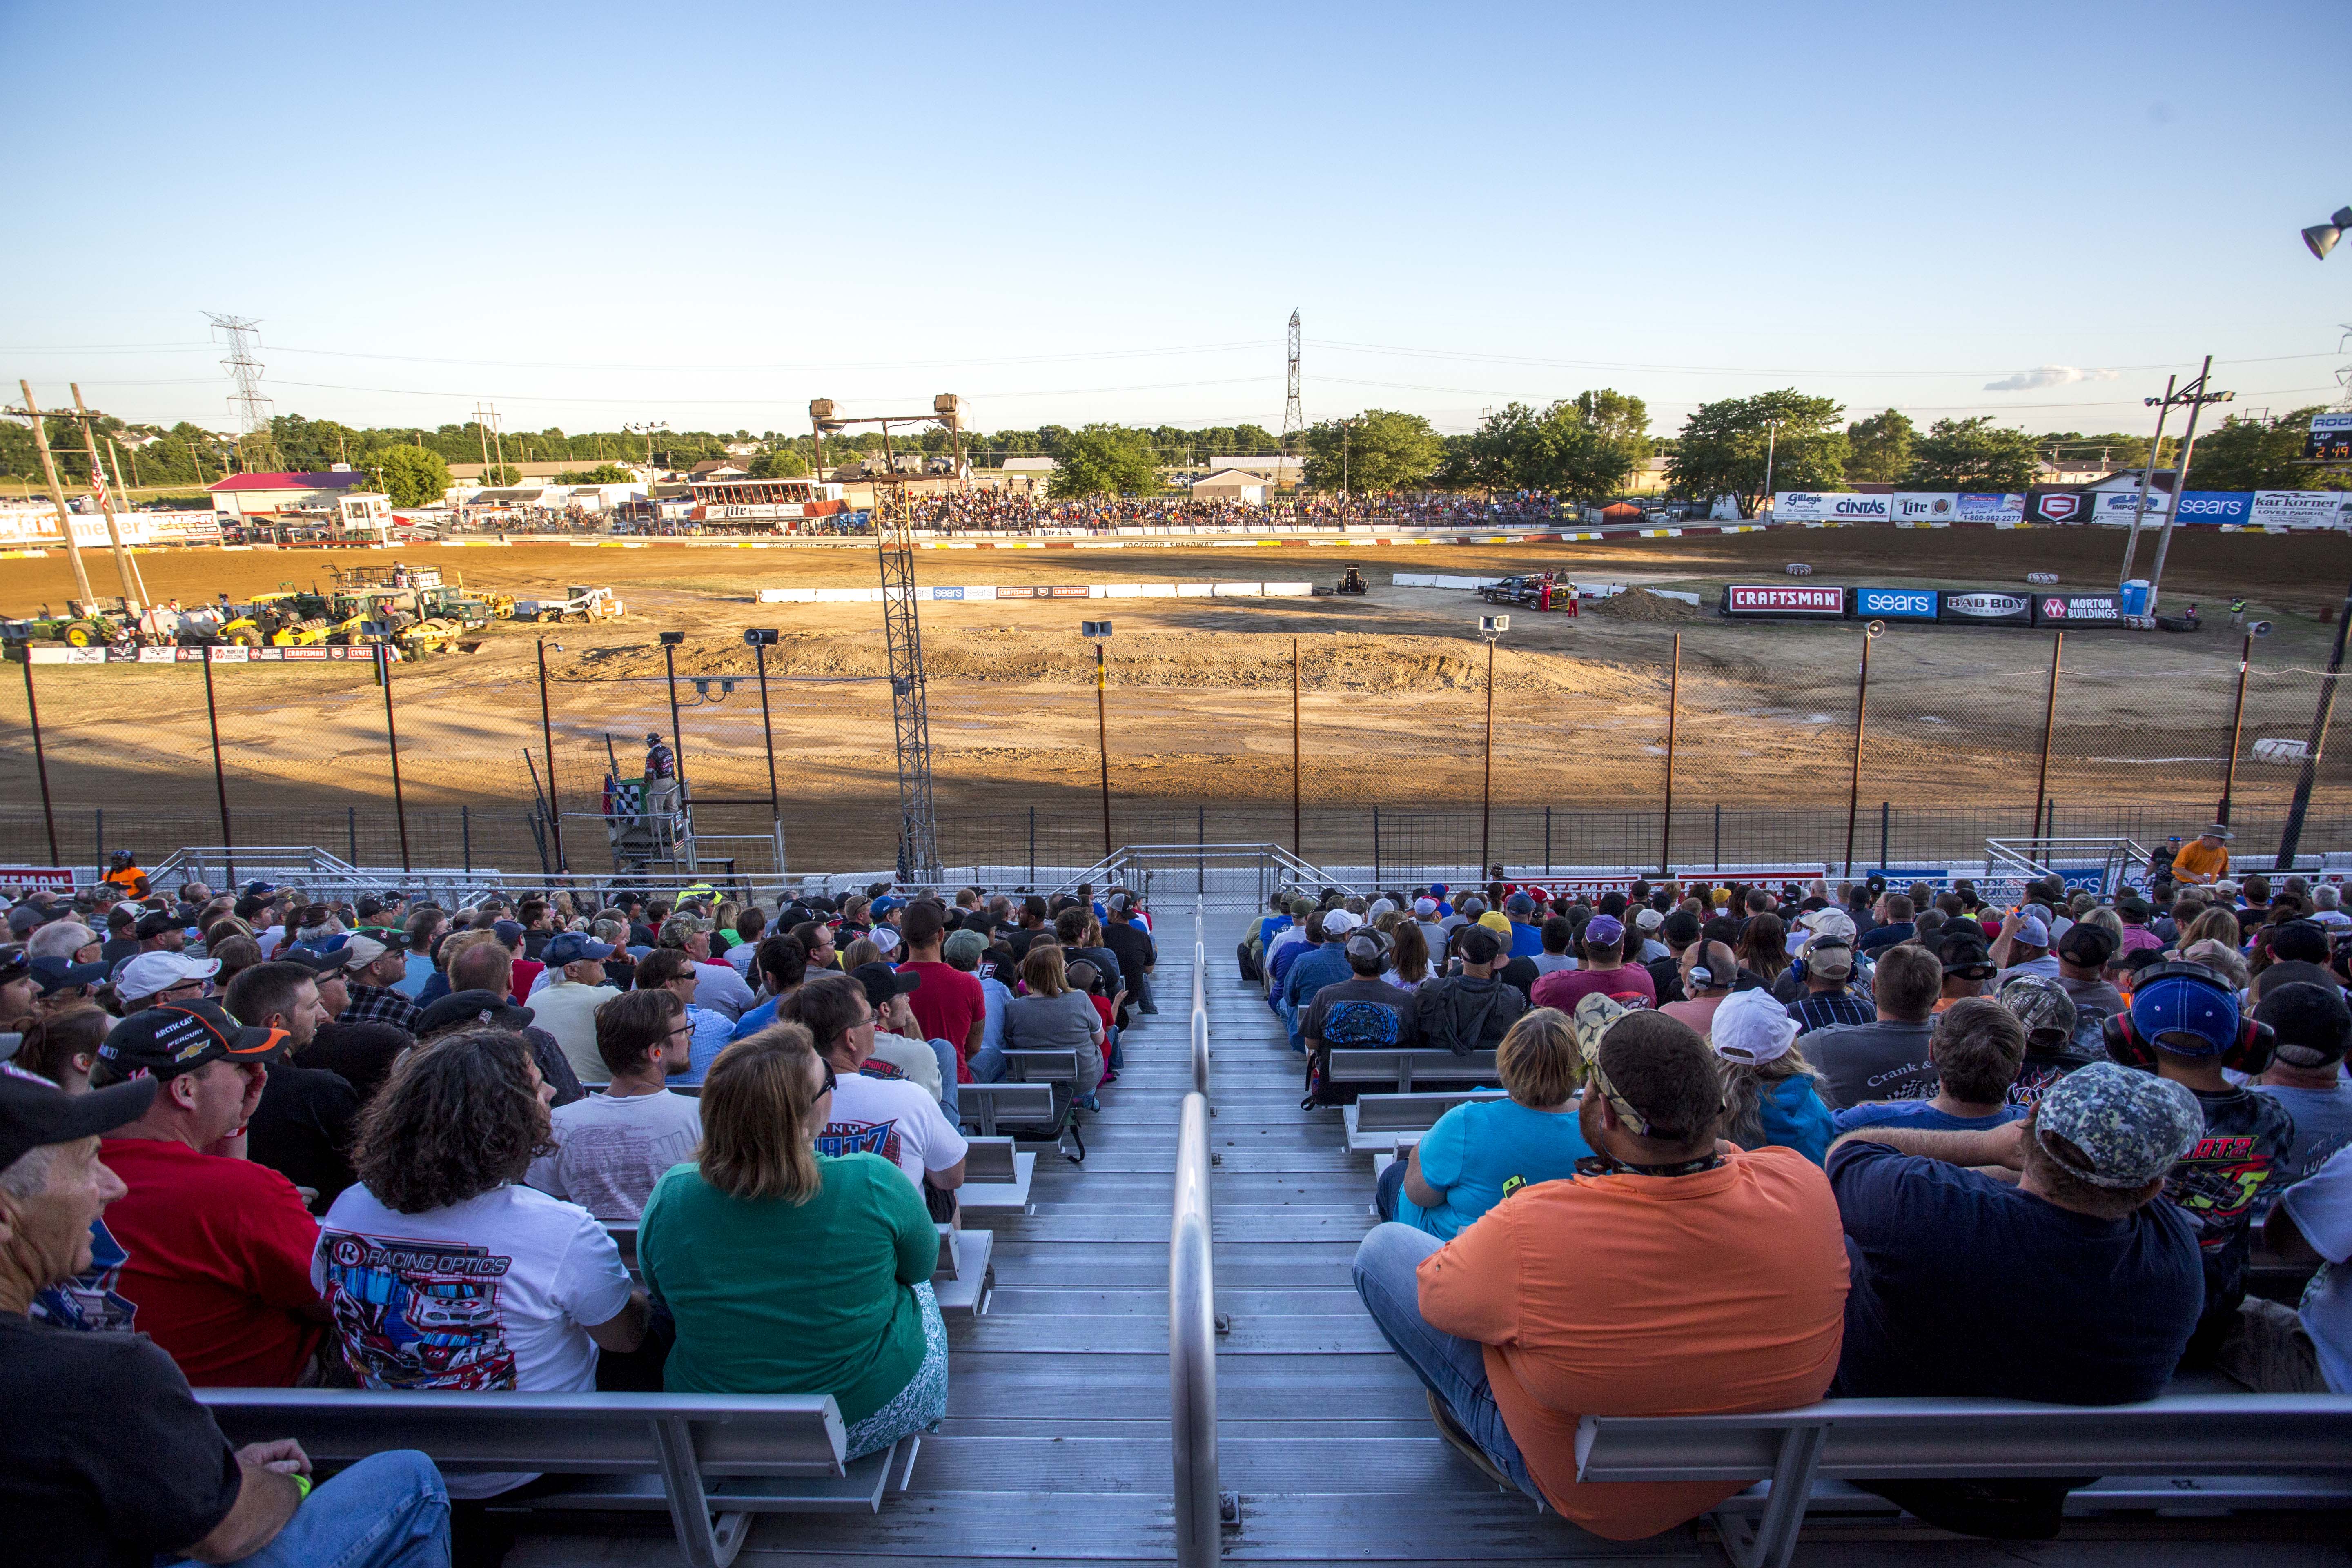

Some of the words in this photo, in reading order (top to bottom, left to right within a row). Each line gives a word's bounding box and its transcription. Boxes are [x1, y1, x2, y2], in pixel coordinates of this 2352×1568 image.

[2316, 447, 2326, 457] 2
[2332, 446, 2349, 457] 49
[1784, 493, 1822, 506] Gilley's
[2107, 495, 2158, 507] NELSNS
[2254, 497, 2283, 506] kar
[2283, 498, 2338, 507] korner
[726, 506, 746, 517] Lite
[1902, 501, 1927, 515] Lite
[2179, 500, 2241, 515] sears
[935, 589, 962, 597] sears
[1737, 592, 1835, 606] CRAFTSMAN
[1868, 595, 1929, 611] sears
[2070, 599, 2113, 608] MORTON
[2067, 608, 2118, 619] BUILDINGS
[155, 1022, 181, 1039] ARCTIC
[180, 1015, 194, 1028] CAT
[167, 1028, 204, 1049] MERCURY
[128, 1066, 150, 1080] 14
[1866, 1062, 1919, 1087] Crank
[1922, 1060, 1933, 1069] &
[367, 1251, 436, 1272] RACING
[436, 1255, 510, 1276] OPTICS
